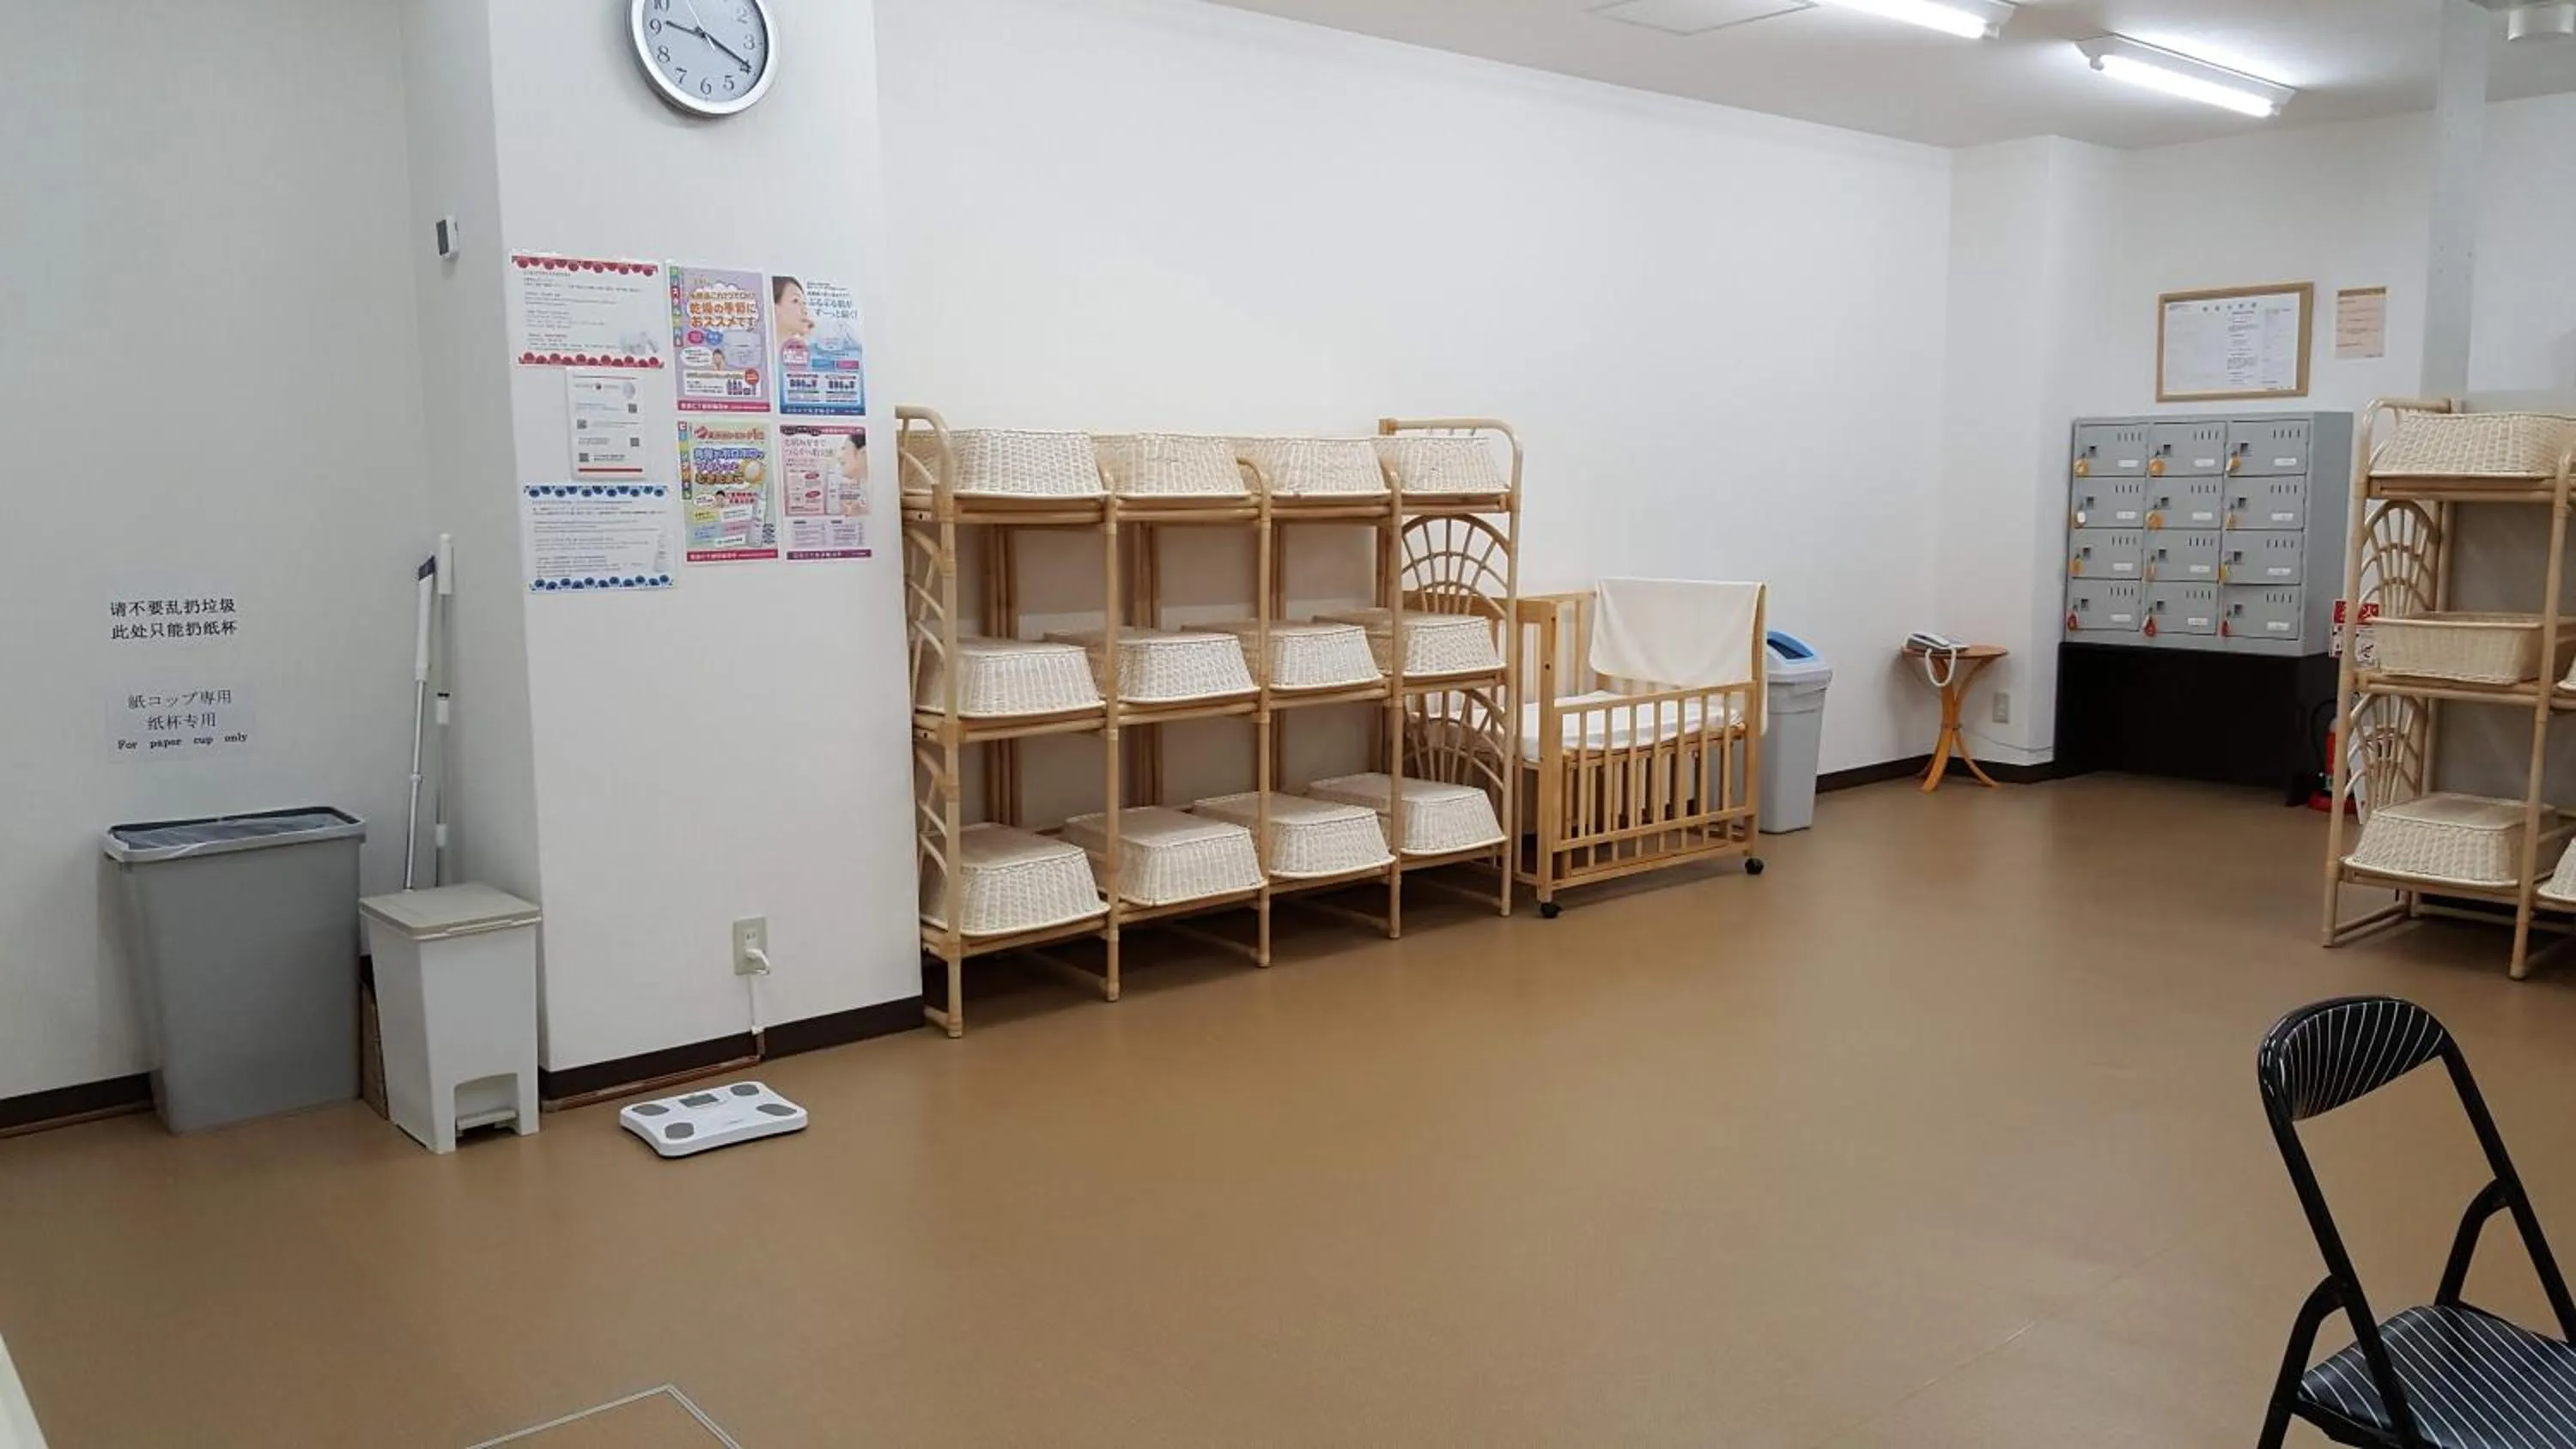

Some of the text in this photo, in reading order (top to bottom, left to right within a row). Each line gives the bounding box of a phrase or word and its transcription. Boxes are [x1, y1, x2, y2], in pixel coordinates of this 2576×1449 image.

[737, 7, 749, 24] 2
[649, 18, 662, 34] 9
[744, 33, 756, 50] 3
[657, 45, 671, 63] 8
[675, 67, 688, 84] 7
[739, 60, 752, 74] 4
[700, 77, 712, 94] 6
[722, 75, 734, 90] 5
[690, 301, 756, 314] 乾燥の季節に
[690, 316, 756, 329] おススメです
[110, 598, 235, 617] 请不要乱扔垃圾
[111, 621, 237, 640] 此处只能扔纸杯
[129, 689, 231, 709] 紙コップ専用
[148, 712, 216, 730] 纸杯专用
[118, 732, 248, 749] For paper cup only
